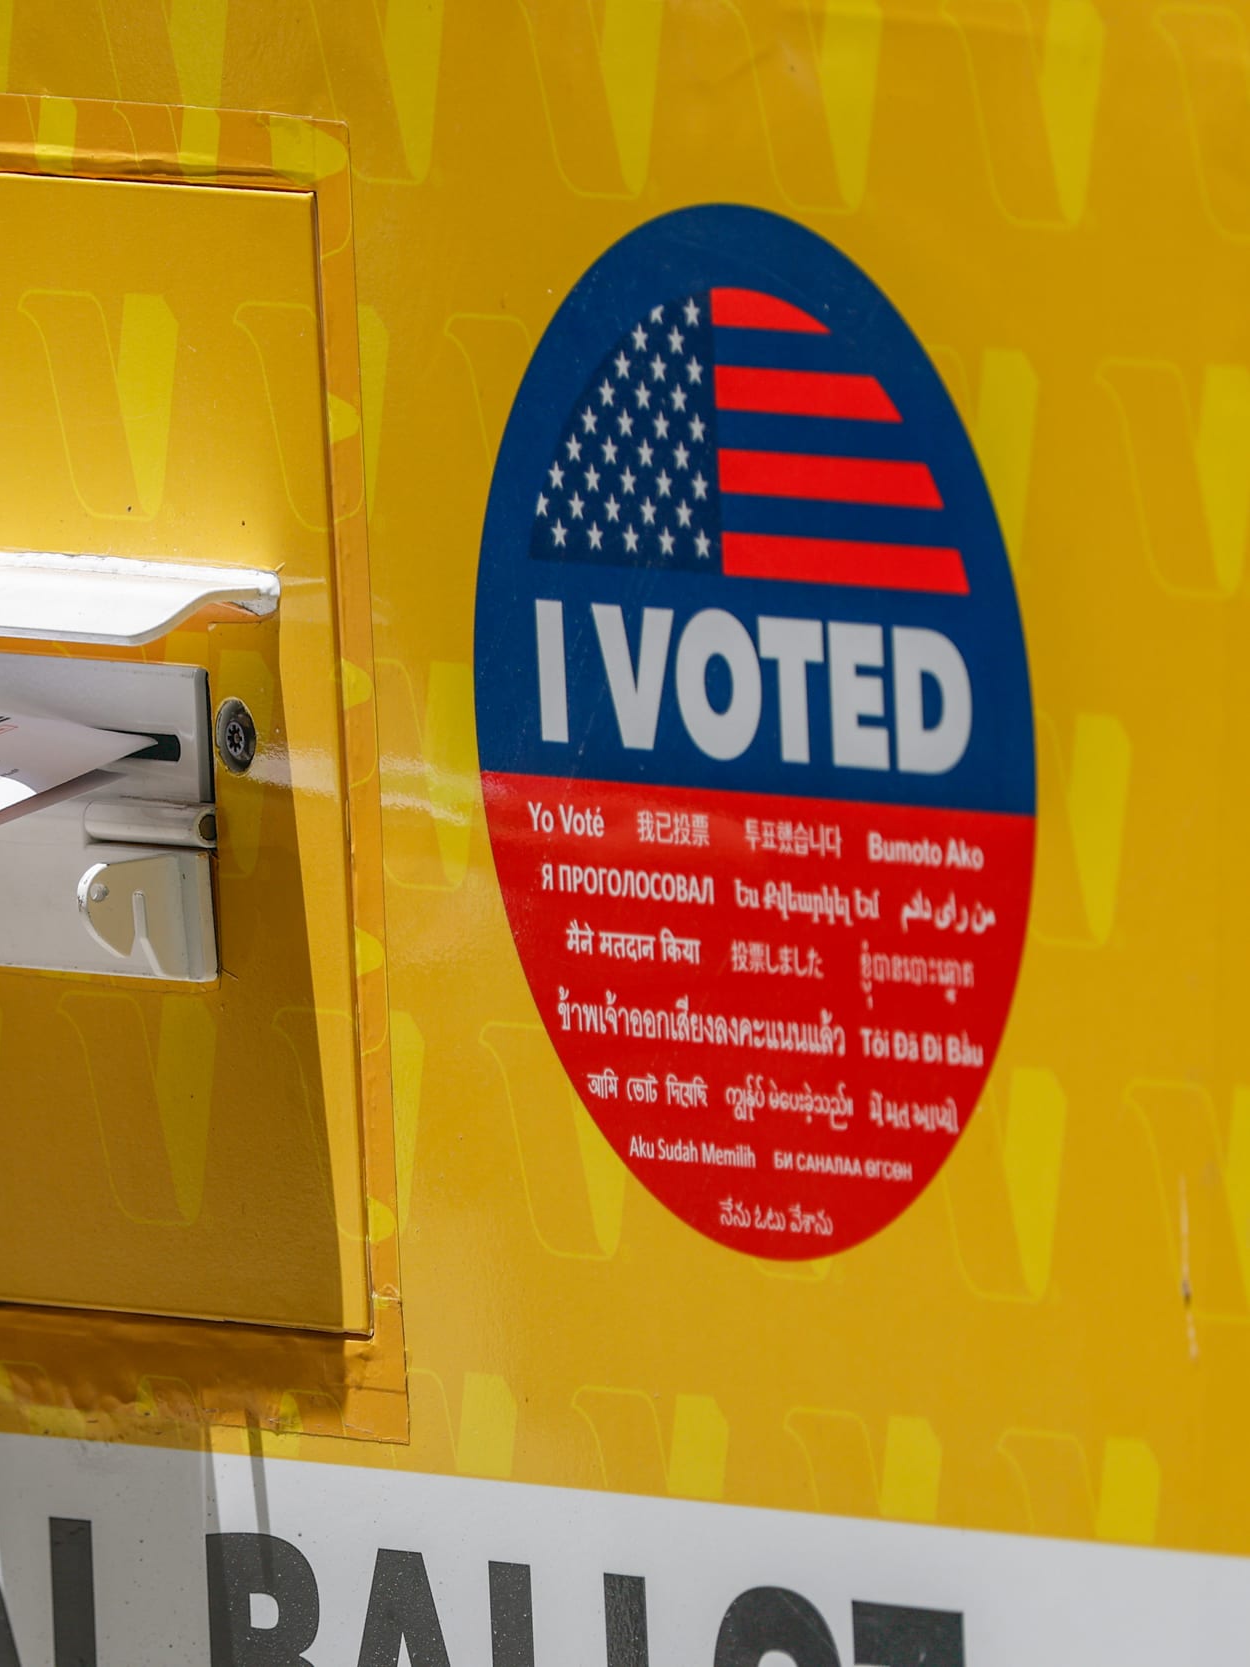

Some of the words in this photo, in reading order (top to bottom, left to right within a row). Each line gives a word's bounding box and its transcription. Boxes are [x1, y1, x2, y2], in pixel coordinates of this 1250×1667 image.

[535, 598, 569, 743] I
[590, 602, 972, 776] VOTED
[528, 801, 554, 832] Yo
[559, 802, 605, 837] Voté
[637, 810, 710, 847] 我已投票
[744, 818, 842, 859] 투표했습니다
[867, 831, 942, 867] Bumoto
[945, 838, 985, 870] Ako
[542, 863, 554, 891] Я
[558, 864, 715, 905] ПРОГОЛОСОВАЛ
[598, 931, 656, 962] मतदान
[659, 926, 701, 965] किया
[731, 939, 825, 979] 投票しました
[859, 1027, 890, 1058] Tôi
[587, 1067, 619, 1100] আমি
[630, 1135, 655, 1160] Aku
[658, 1138, 699, 1163] Sudah
[702, 1142, 756, 1169] Memilih
[773, 1151, 793, 1170] БИ
